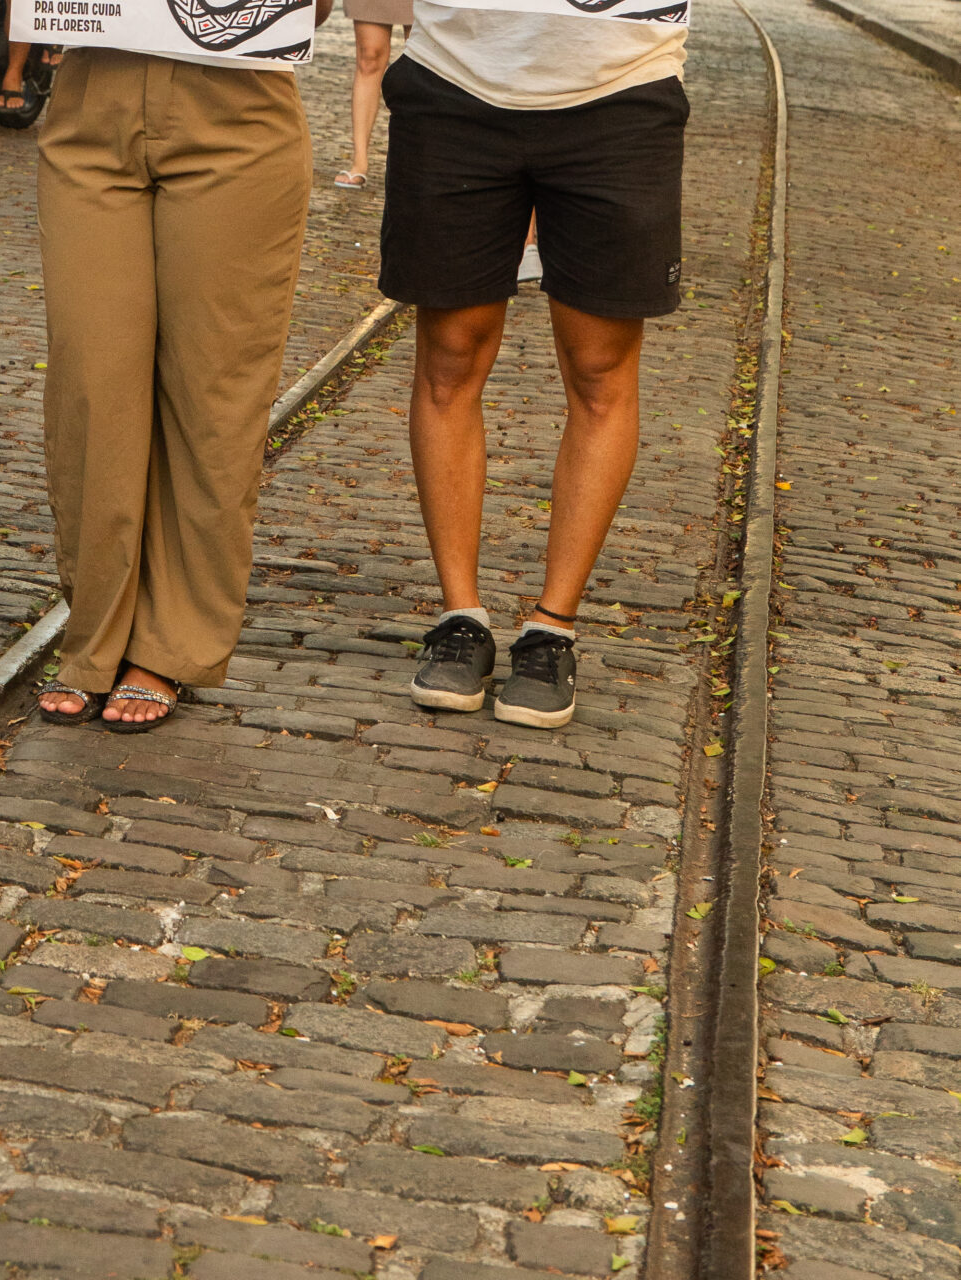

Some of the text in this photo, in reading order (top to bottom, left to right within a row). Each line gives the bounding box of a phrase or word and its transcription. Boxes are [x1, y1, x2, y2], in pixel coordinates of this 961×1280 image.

[35, 0, 121, 16] PRA QUEM CUIDA
[34, 18, 104, 32] DA FLORESTA.
